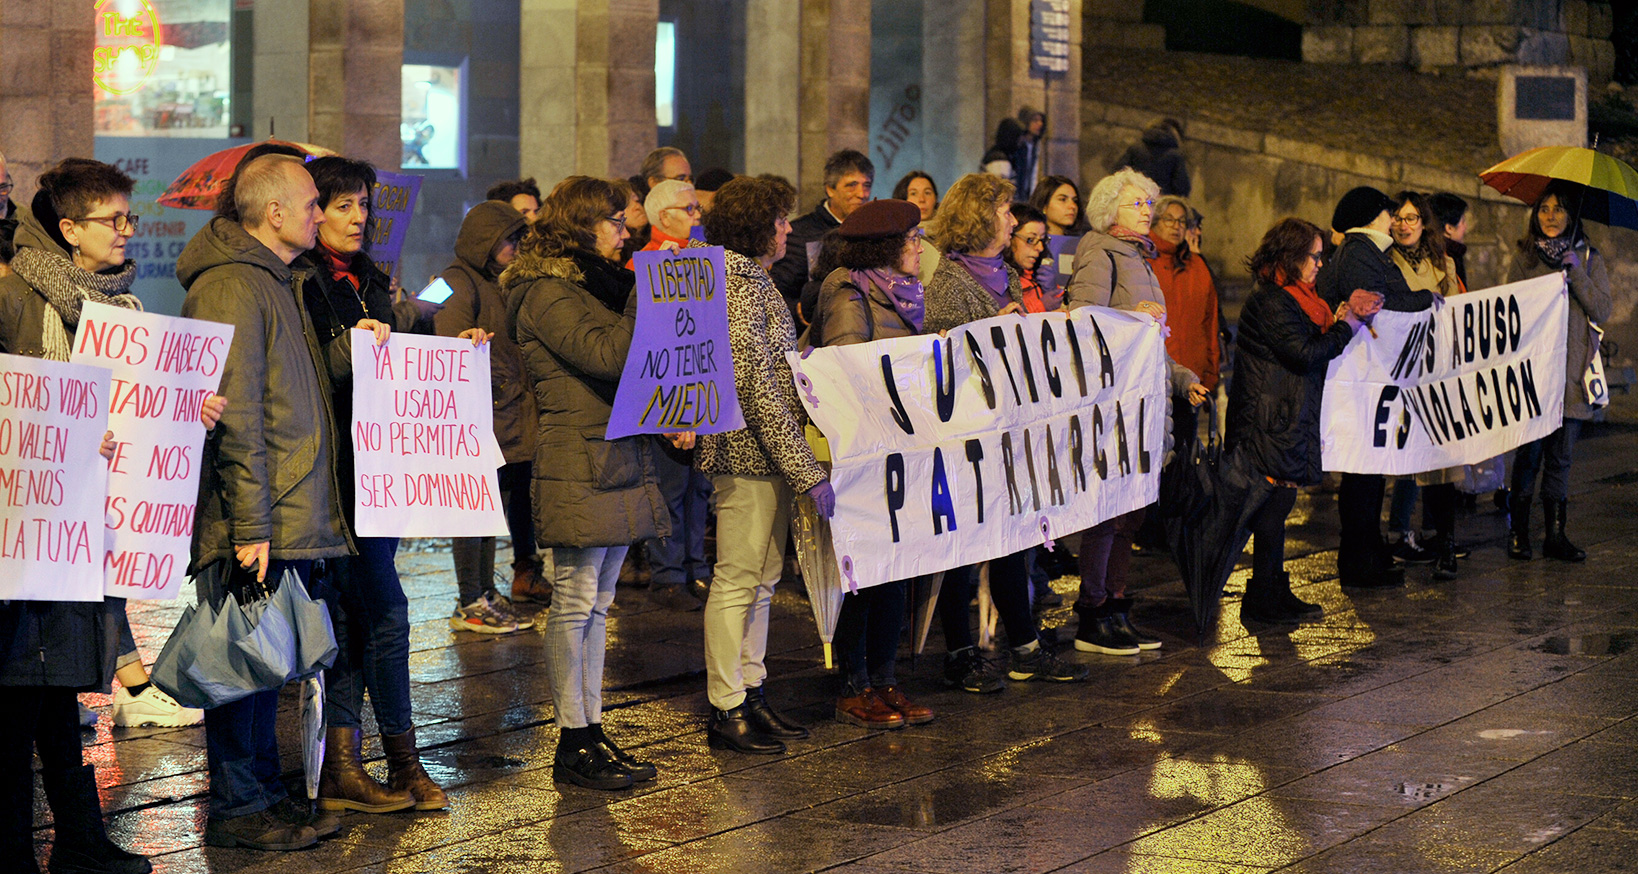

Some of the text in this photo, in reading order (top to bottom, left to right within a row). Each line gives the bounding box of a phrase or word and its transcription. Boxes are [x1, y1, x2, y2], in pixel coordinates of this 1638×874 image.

[101, 11, 144, 36] THE
[136, 222, 186, 237] UVENIR
[126, 242, 149, 258] RTS
[155, 242, 164, 258] &
[647, 256, 716, 303] LIBERTAD
[675, 307, 696, 338] es
[1451, 294, 1521, 369] ABUSO
[79, 319, 225, 377] NOS HABEIS
[372, 344, 470, 383] YA FUISTE
[640, 339, 718, 380] NO TENER
[881, 314, 1115, 435] JUSTICIA
[0, 371, 98, 420] STRAS VIDAS
[109, 379, 168, 418] TADO
[395, 389, 458, 420] USADA
[638, 380, 720, 428] MIEDO
[1404, 358, 1542, 446] VIOLACION
[0, 418, 69, 463] O VALEN
[357, 421, 480, 460] NO PERMITAS
[146, 445, 192, 481] NOS
[886, 397, 1151, 543] PATRIARCAL
[0, 467, 65, 507] MENOS
[361, 473, 495, 511] SER DOMINADA
[130, 501, 197, 537] QUITADO
[2, 518, 92, 565] LA TUYA
[103, 550, 174, 590] MIEDO
